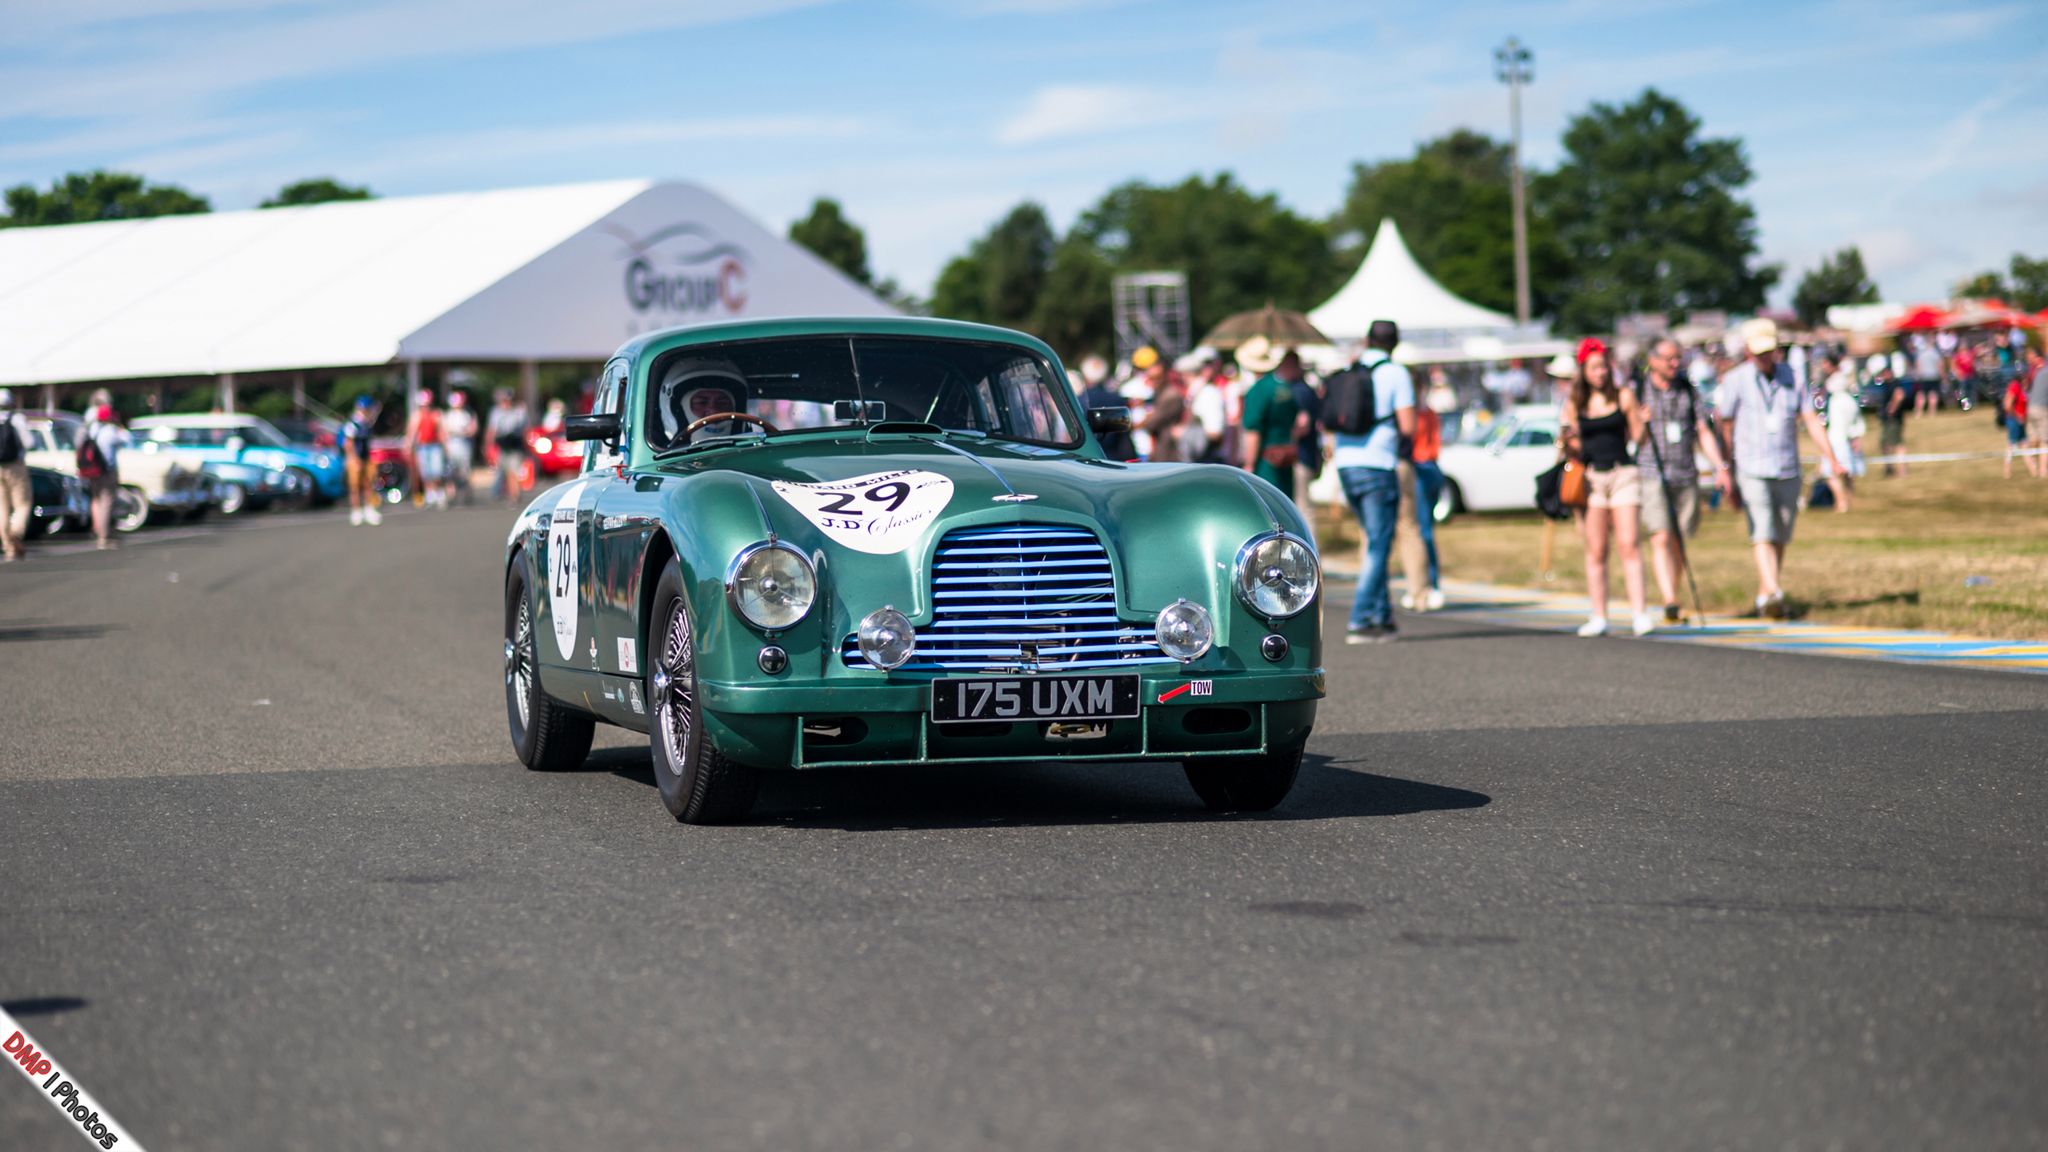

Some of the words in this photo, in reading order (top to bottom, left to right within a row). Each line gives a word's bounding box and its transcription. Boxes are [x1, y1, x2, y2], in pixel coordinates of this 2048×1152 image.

[815, 481, 911, 516] 29
[555, 534, 571, 598] 29
[958, 681, 1021, 718] 175
[1032, 679, 1113, 716] UXM
[1192, 681, 1212, 695] TOW
